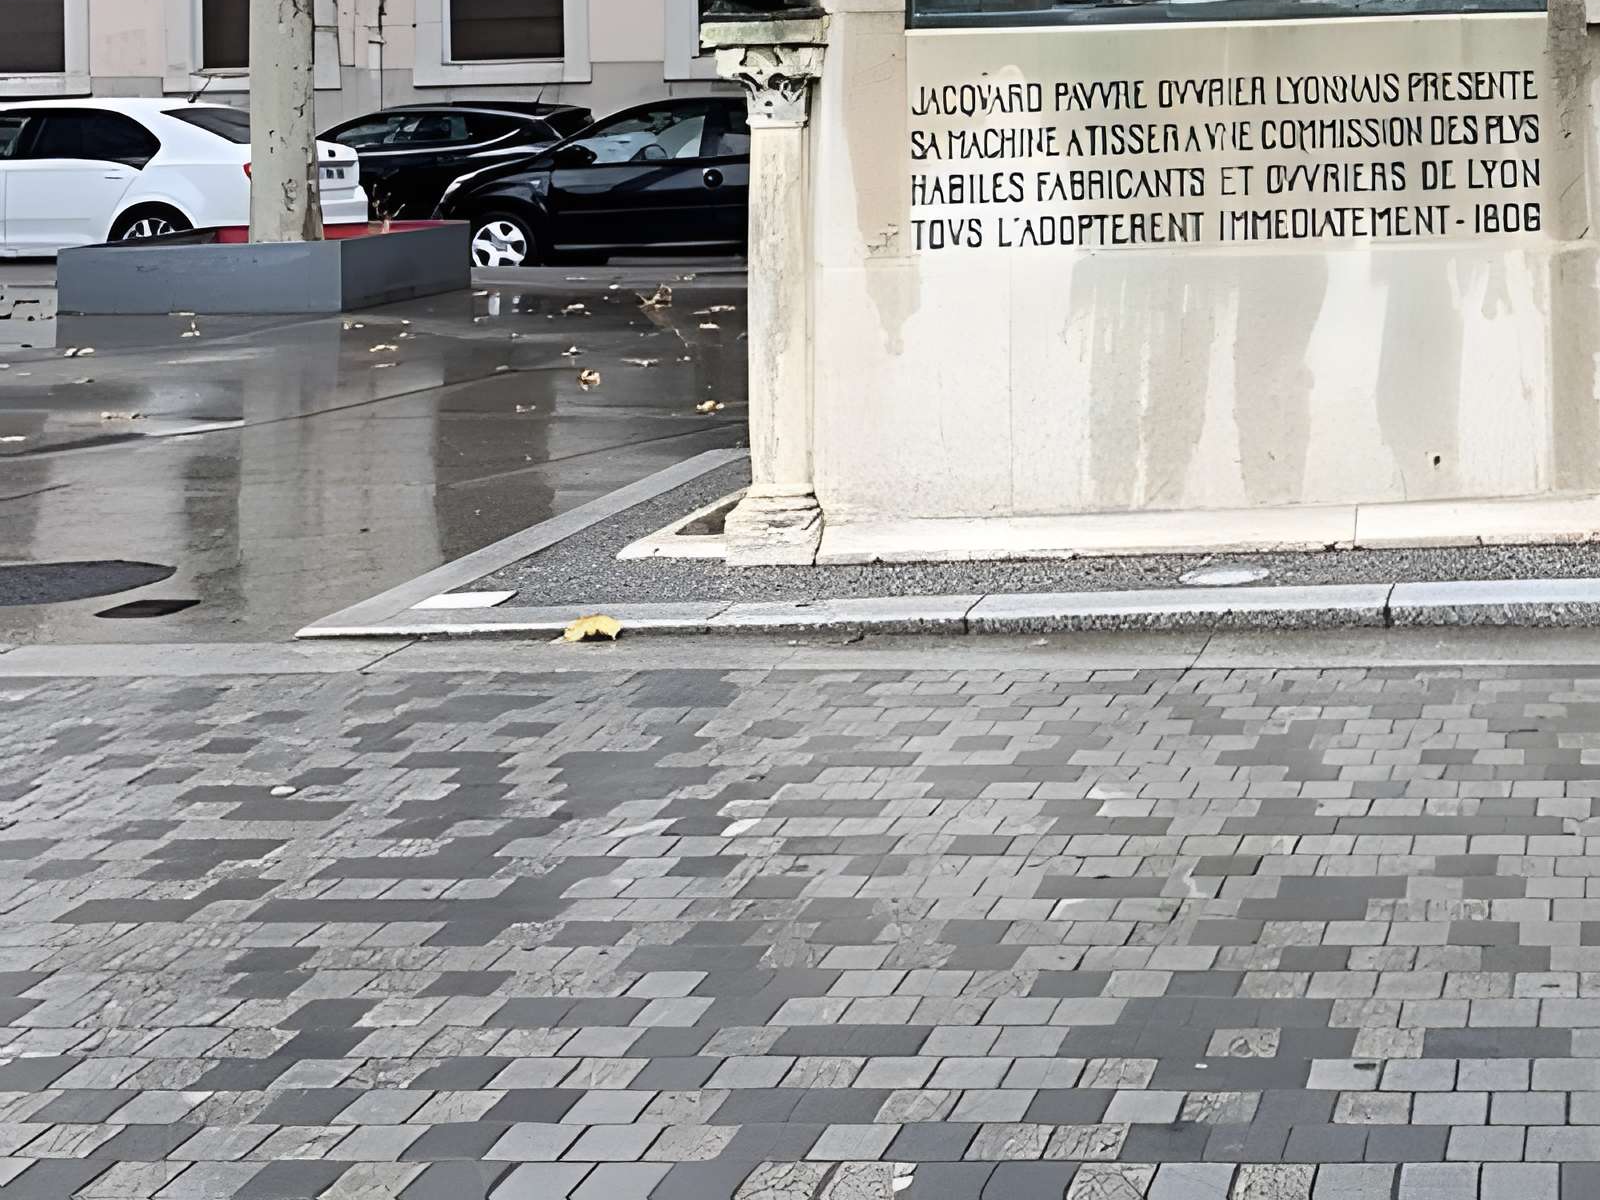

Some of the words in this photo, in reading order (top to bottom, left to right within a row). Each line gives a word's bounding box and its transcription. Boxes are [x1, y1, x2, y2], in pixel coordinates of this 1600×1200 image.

[912, 83, 1042, 117] JACQVARD
[1055, 81, 1147, 111] PAVVRE
[1409, 71, 1537, 101] PRESENTE
[911, 131, 941, 159] SA
[948, 127, 1059, 159] MACHINE
[1067, 130, 1083, 156] A
[1085, 124, 1178, 155] TISSER
[1185, 126, 1201, 152] A
[1262, 117, 1422, 152] COMMISSION
[1431, 116, 1477, 146] DES
[1486, 115, 1539, 144] PLVS
[912, 172, 1024, 205] HABILES
[1037, 168, 1204, 201] FABRICANTS
[1221, 166, 1253, 195] ET
[1422, 160, 1456, 190] DE
[1468, 159, 1540, 188] LYON
[911, 219, 982, 250] TOVS
[999, 212, 1204, 248] L'ADOPTERENT
[1220, 206, 1450, 240] IMMEDIATEMENT
[1476, 203, 1541, 233] 1806
